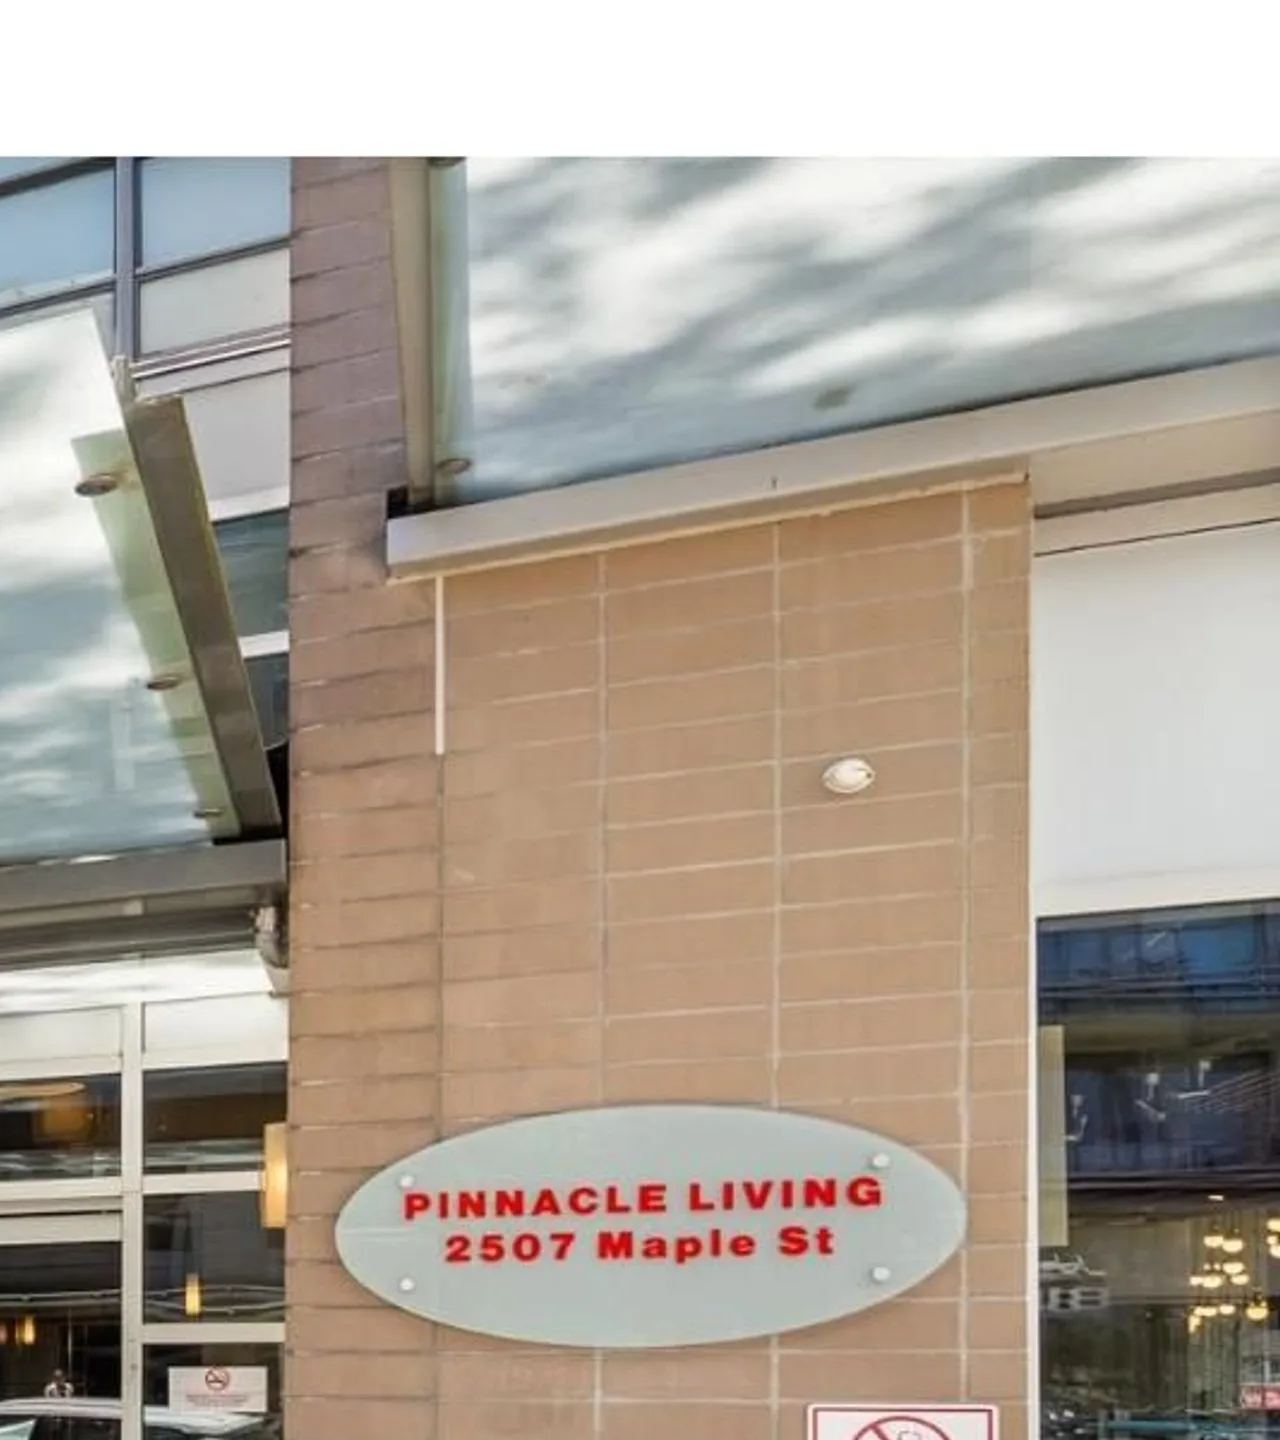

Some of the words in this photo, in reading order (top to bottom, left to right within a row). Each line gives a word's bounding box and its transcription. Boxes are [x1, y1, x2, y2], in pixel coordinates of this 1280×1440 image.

[402, 1182, 666, 1220] PINNACLE
[688, 1175, 884, 1214] LIVING
[445, 1231, 577, 1264] 2507
[595, 1228, 758, 1265] Maple
[779, 1224, 834, 1257] St
